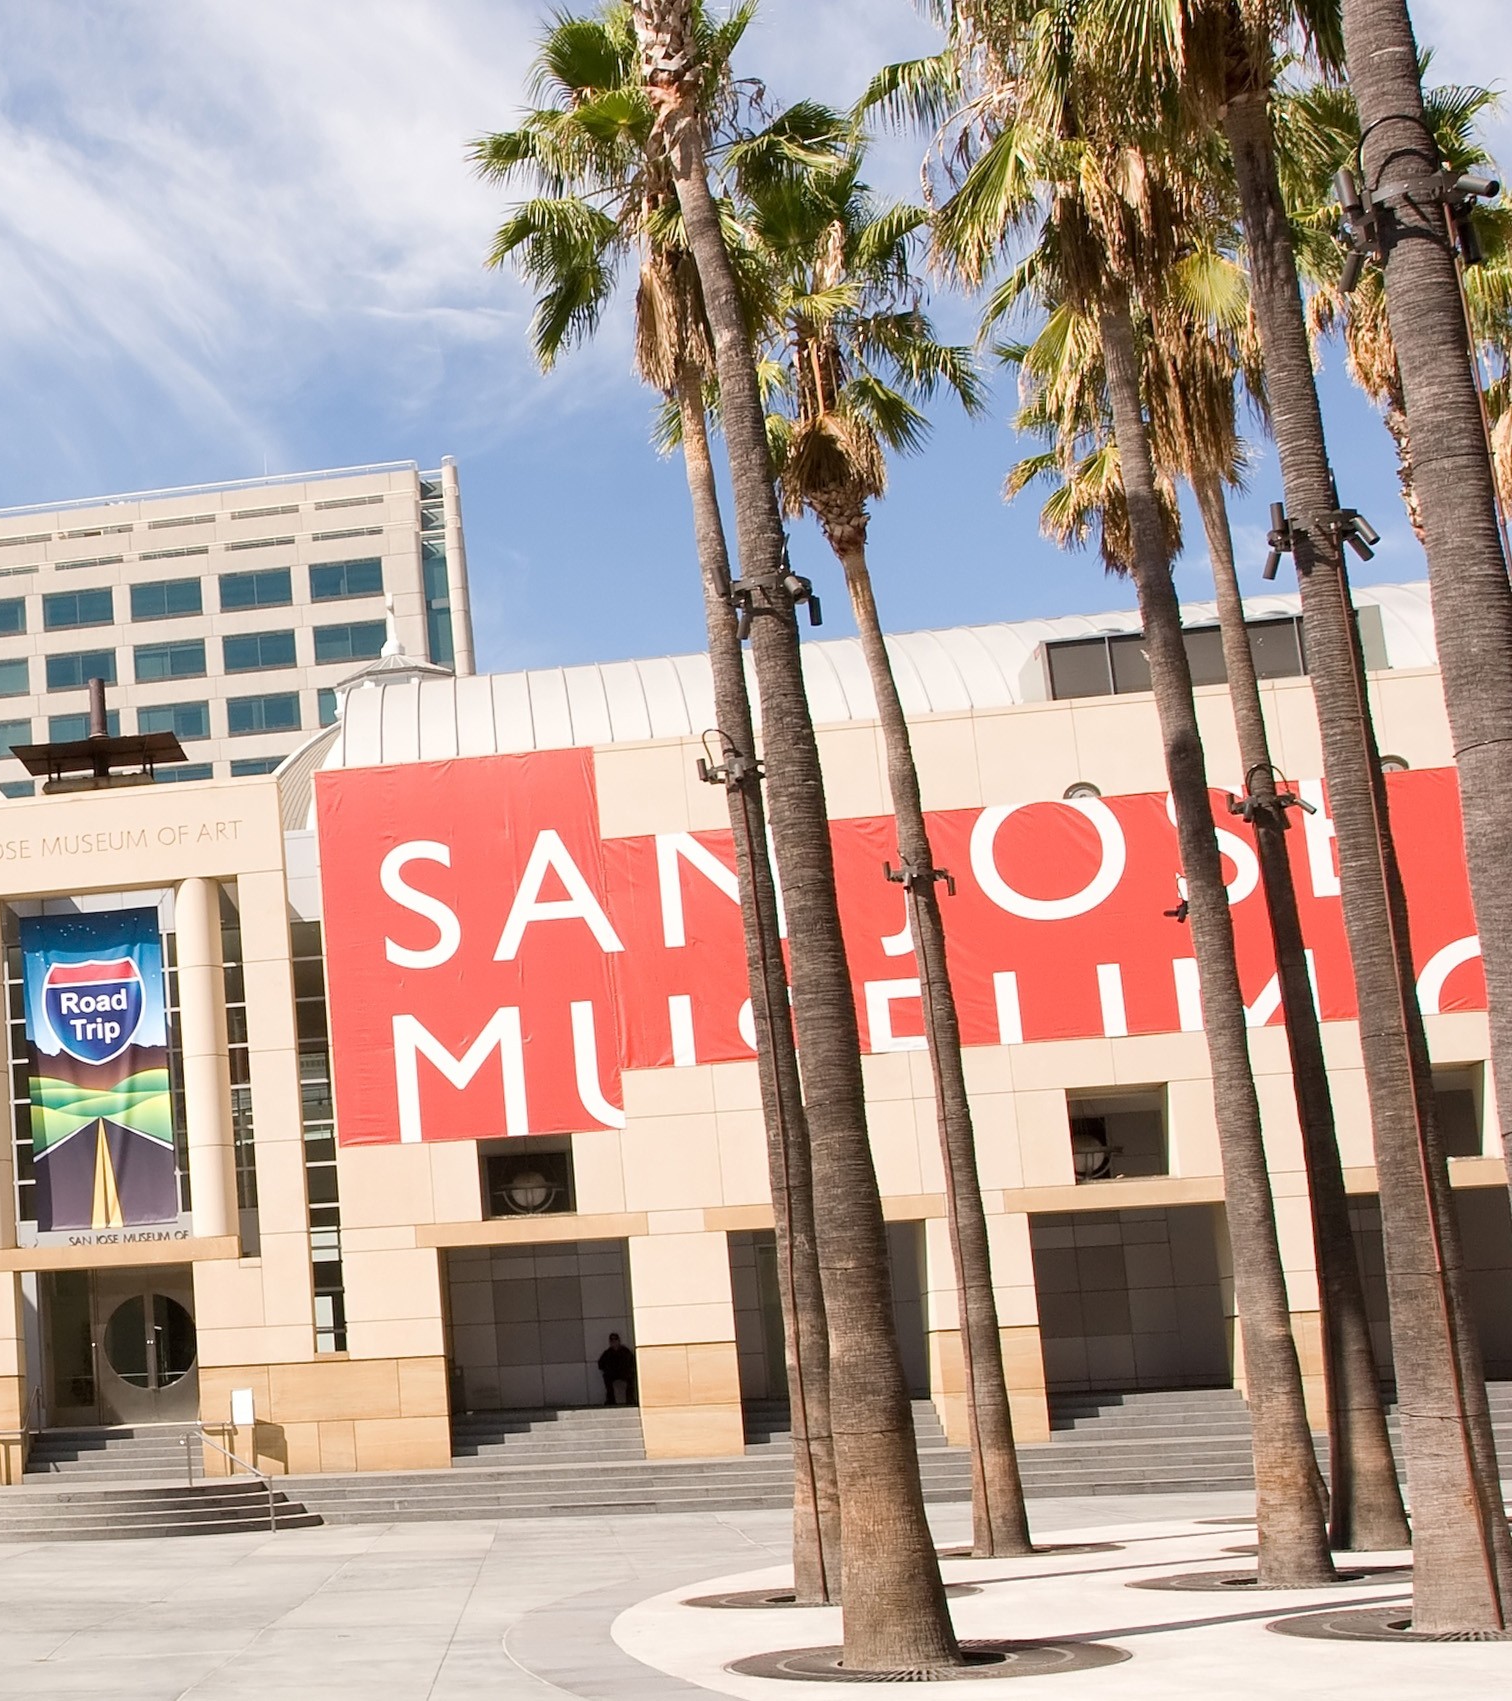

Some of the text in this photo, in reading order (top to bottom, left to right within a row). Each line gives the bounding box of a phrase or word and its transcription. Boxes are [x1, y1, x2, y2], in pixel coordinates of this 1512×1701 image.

[41, 828, 149, 857] MUSEUM
[157, 824, 190, 846] OF
[196, 820, 244, 842] ART
[380, 823, 788, 970] SAN
[60, 987, 128, 1015] Road
[69, 1018, 121, 1044] Trip
[68, 1235, 92, 1247] SAN
[123, 1231, 171, 1243] MUSEUM
[174, 1230, 190, 1241] OF
